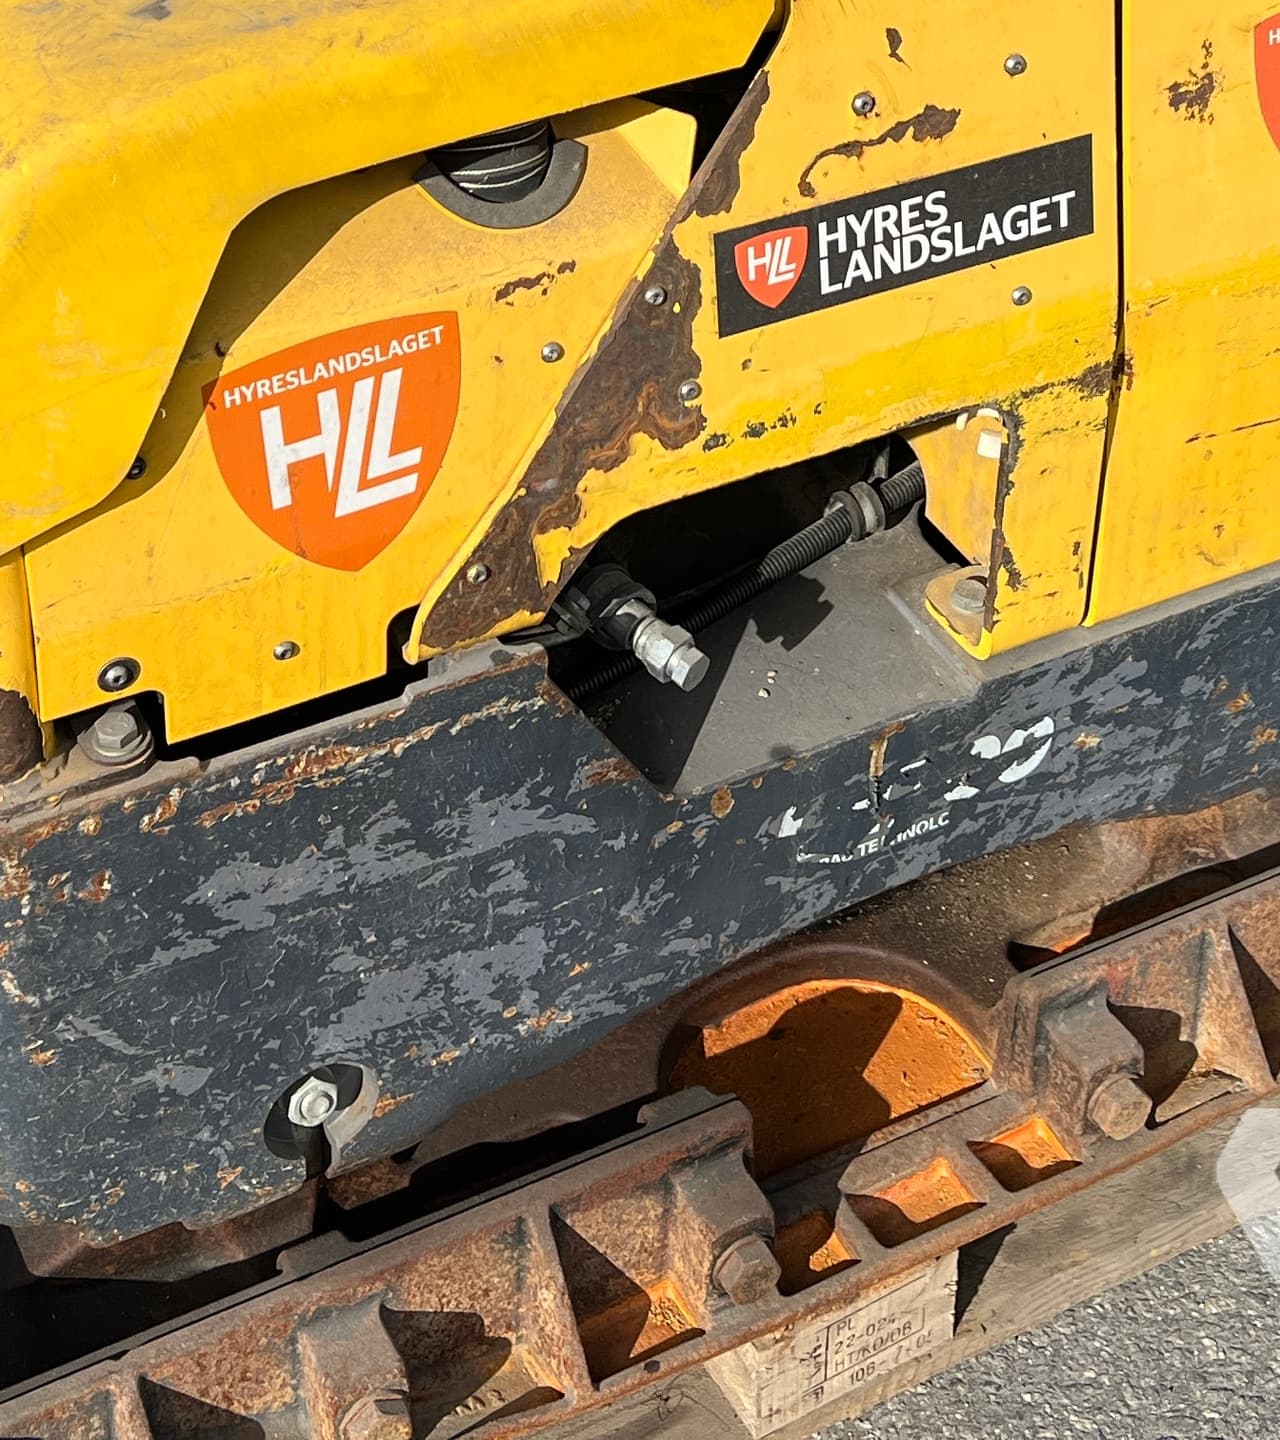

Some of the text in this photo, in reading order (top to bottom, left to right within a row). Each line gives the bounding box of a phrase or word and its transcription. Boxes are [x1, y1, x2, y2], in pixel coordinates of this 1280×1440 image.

[747, 234, 798, 287] HLL
[817, 189, 948, 260] HYRES
[819, 190, 1076, 295] LANDSLAGET
[223, 325, 445, 409] HYRESLANDSLAGET
[259, 367, 423, 518] HLL
